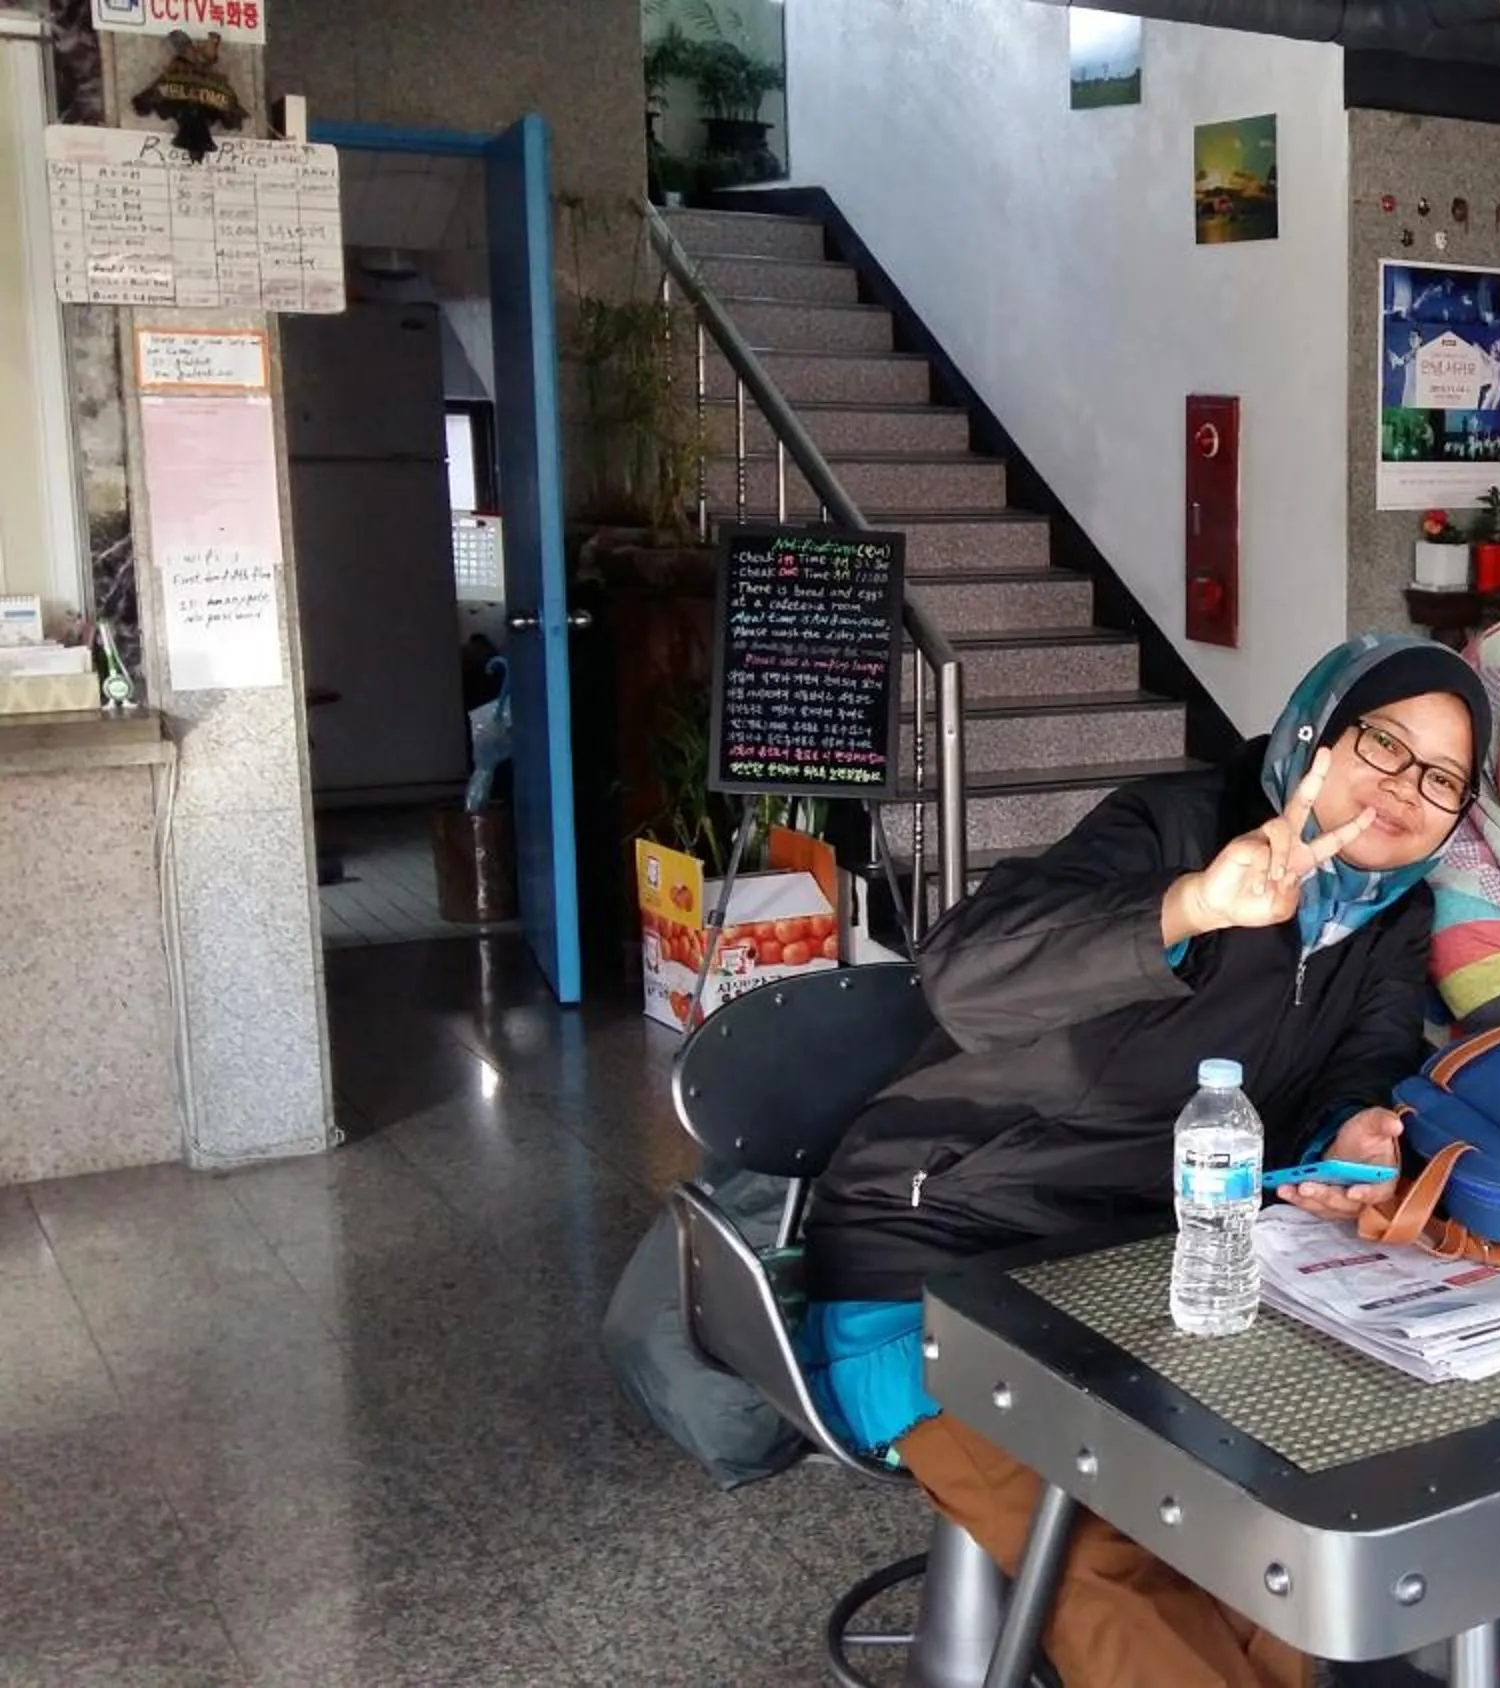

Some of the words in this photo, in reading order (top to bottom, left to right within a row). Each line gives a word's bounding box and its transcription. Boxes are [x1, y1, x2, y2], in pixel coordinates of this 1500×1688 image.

[798, 553, 827, 565] Time
[803, 568, 830, 581] Time
[738, 581, 772, 595] There
